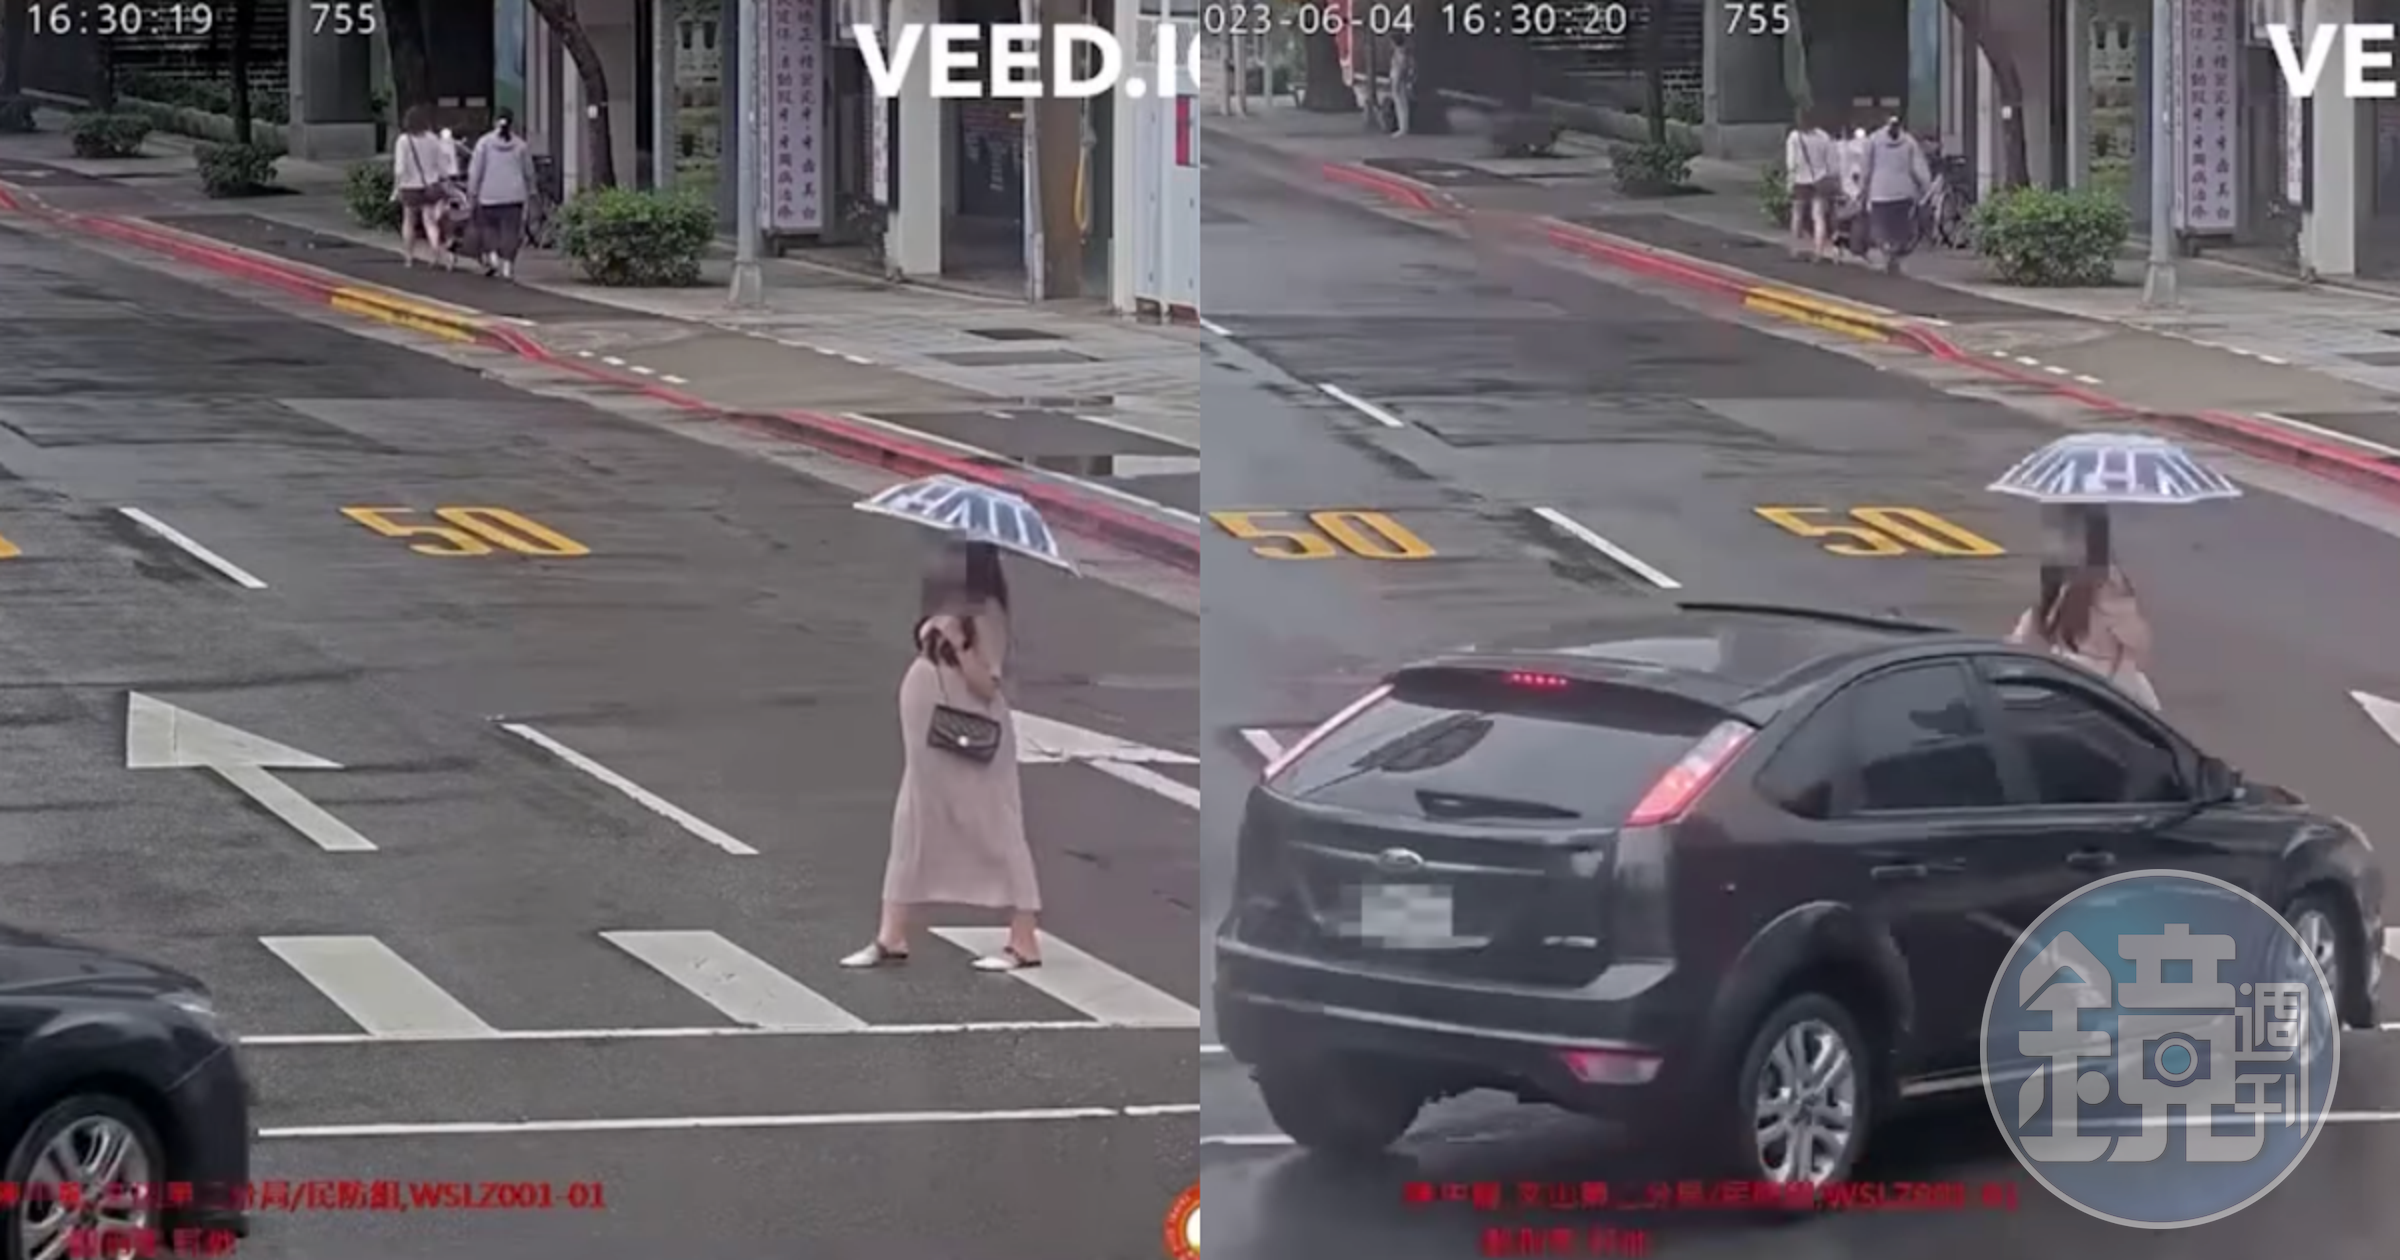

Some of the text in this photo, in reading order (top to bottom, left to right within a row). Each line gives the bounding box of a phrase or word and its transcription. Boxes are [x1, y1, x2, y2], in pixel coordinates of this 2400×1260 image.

[340, 506, 591, 555] 50
[1208, 510, 1438, 560] 50
[1754, 506, 2006, 555] 50
